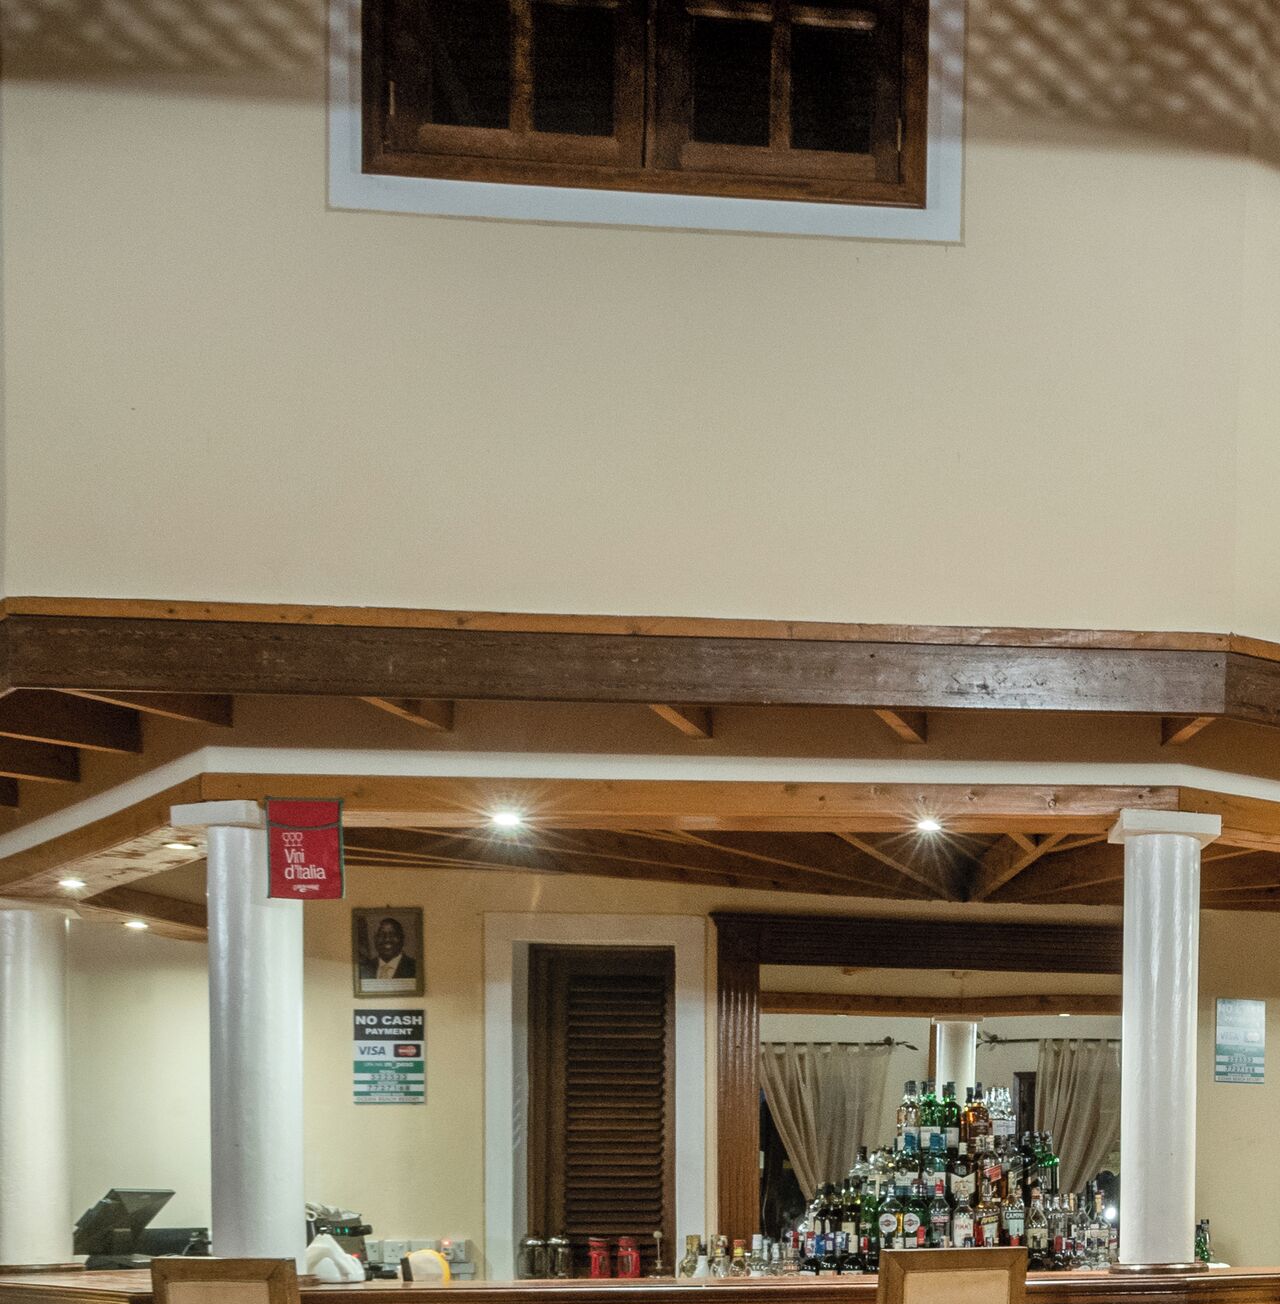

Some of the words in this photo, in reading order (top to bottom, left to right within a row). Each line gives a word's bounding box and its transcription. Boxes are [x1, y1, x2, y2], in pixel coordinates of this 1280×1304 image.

[284, 848, 305, 863] Vini
[284, 864, 326, 880] d'Italia
[355, 1015, 378, 1025] NO
[381, 1015, 423, 1025] CASH
[358, 1046, 386, 1055] VISA
